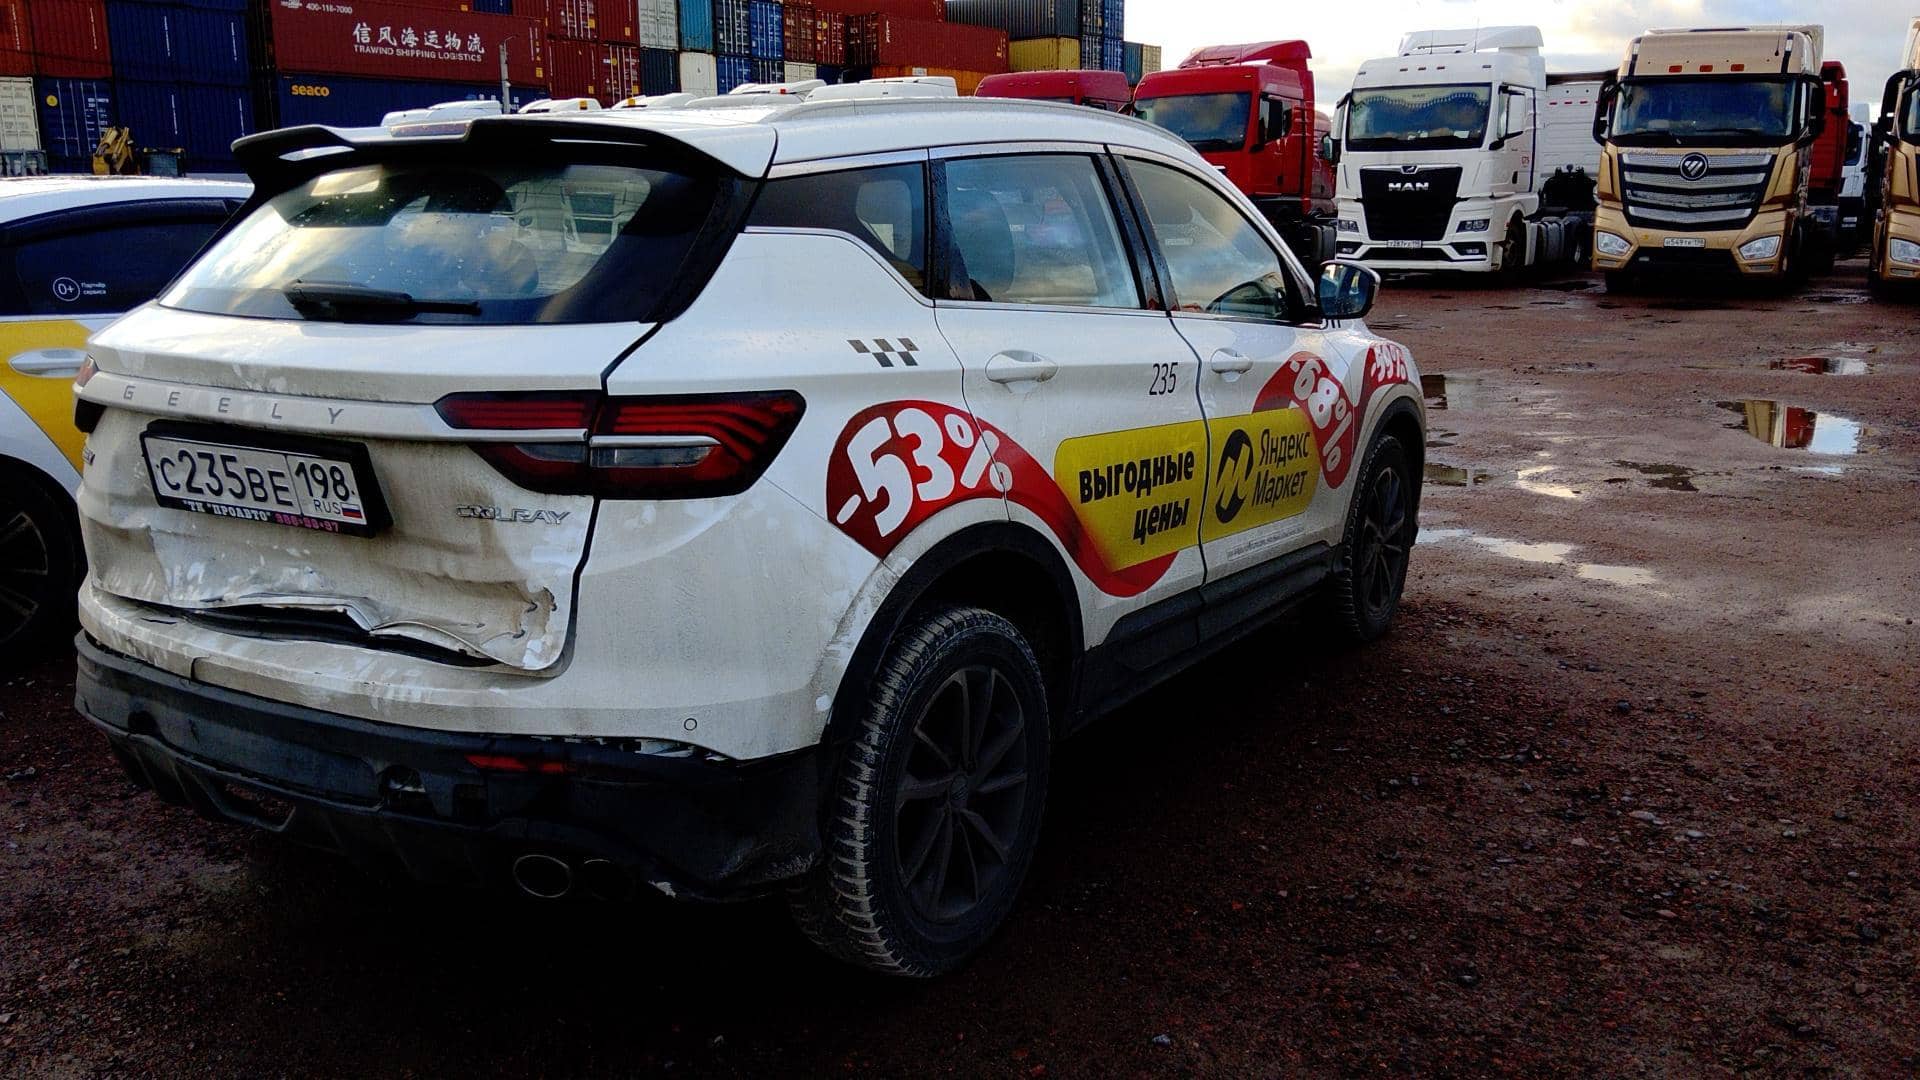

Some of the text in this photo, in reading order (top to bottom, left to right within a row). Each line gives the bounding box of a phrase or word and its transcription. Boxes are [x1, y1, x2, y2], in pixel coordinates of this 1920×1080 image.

[352, 22, 485, 54] 信风海运物流
[353, 44, 482, 62] TRAWIND SHIPPING LOGISTICS
[291, 84, 330, 97] seaco
[1388, 182, 1429, 191] MAN
[58, 283, 75, 295] 0+
[1149, 361, 1178, 395] 235
[123, 385, 344, 425] GEELY
[1289, 358, 1352, 472] -68%
[1259, 428, 1311, 466] Яндекс
[159, 449, 350, 506] С235ВЕ 198
[836, 407, 1013, 537] -53%
[1079, 450, 1195, 504] выгодные
[1252, 470, 1308, 508] Маркет
[313, 499, 341, 515] RUS
[1133, 497, 1190, 546] цены
